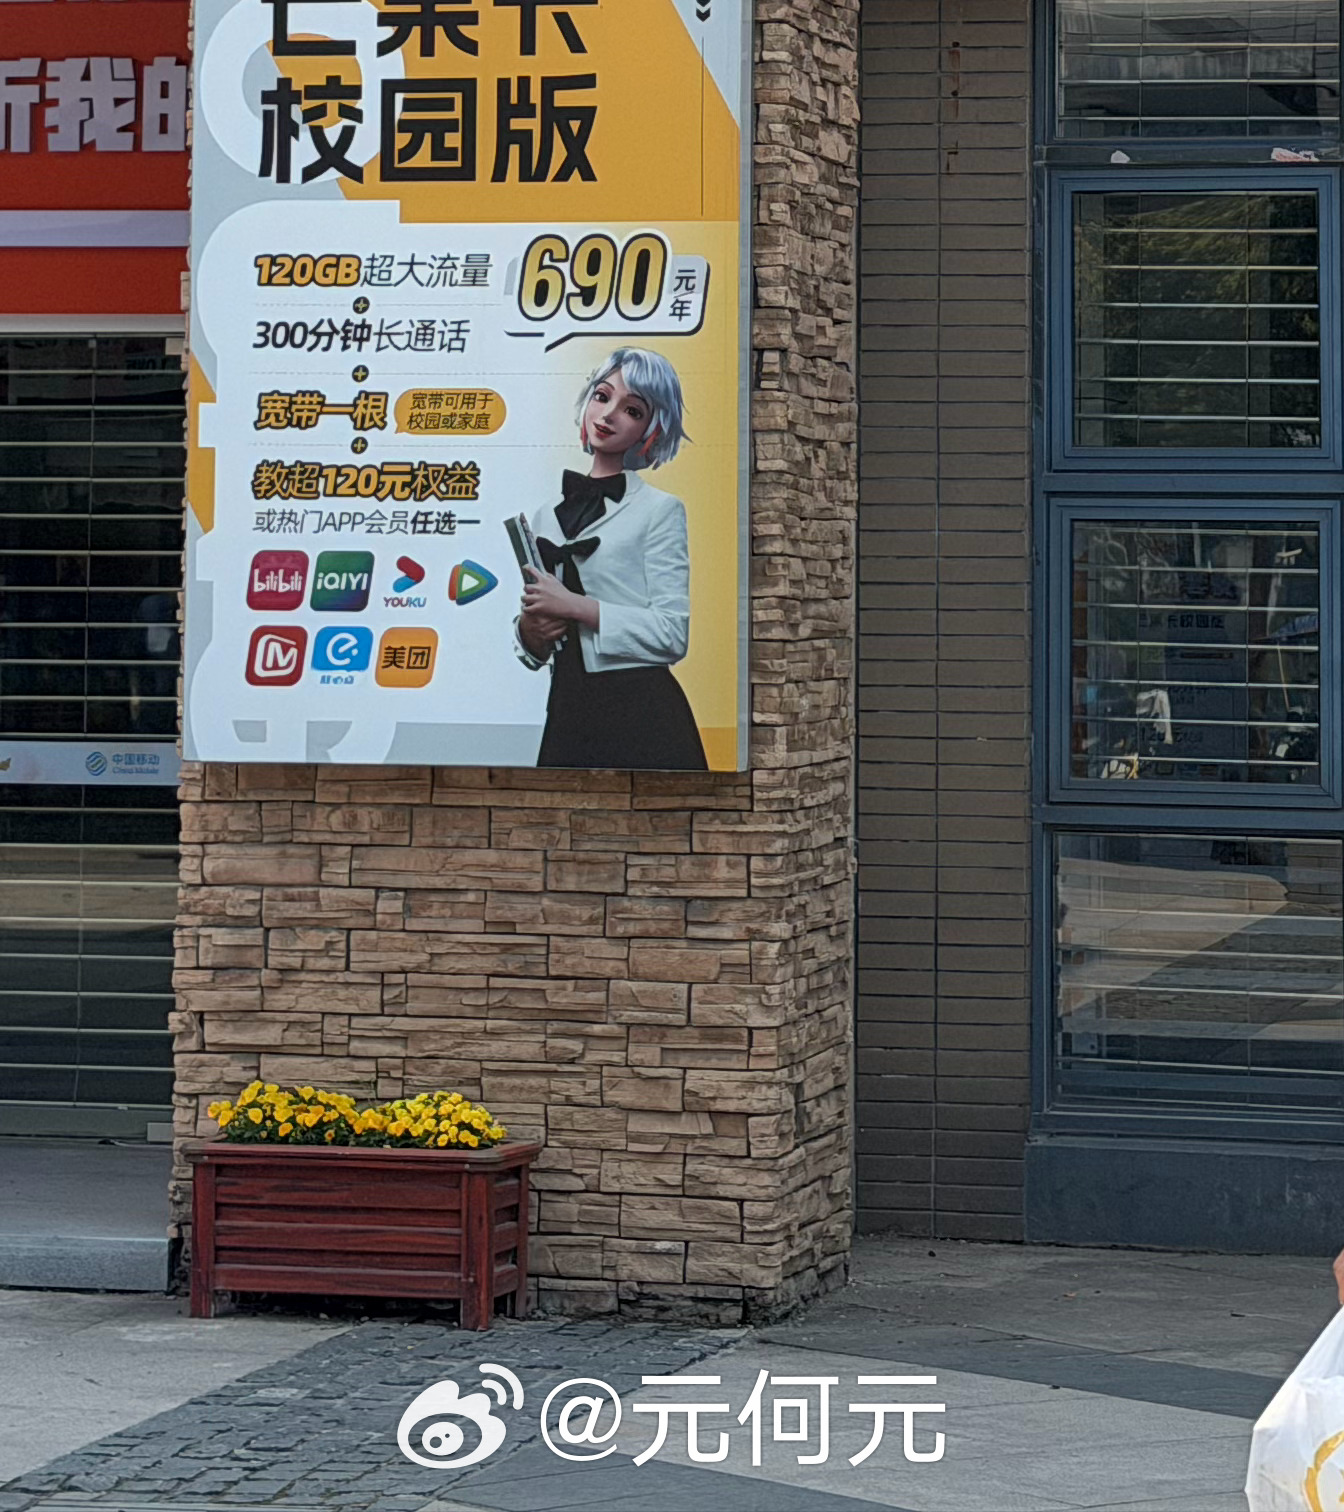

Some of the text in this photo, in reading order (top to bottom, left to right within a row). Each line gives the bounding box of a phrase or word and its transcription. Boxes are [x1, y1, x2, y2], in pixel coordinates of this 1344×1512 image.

[258, 73, 599, 184] 校园版
[254, 252, 493, 288] 120GB超大流量
[516, 232, 668, 322] 690
[253, 317, 471, 354] 300分钟长通话
[254, 391, 388, 431] 宽带一根
[409, 391, 494, 411] 宽带可用于
[406, 411, 491, 431] 校园或家庭
[253, 508, 482, 536] 或热门APP会员任选一
[253, 568, 304, 593] bilibili
[383, 596, 428, 609] YOUKU
[384, 646, 431, 670] 美团
